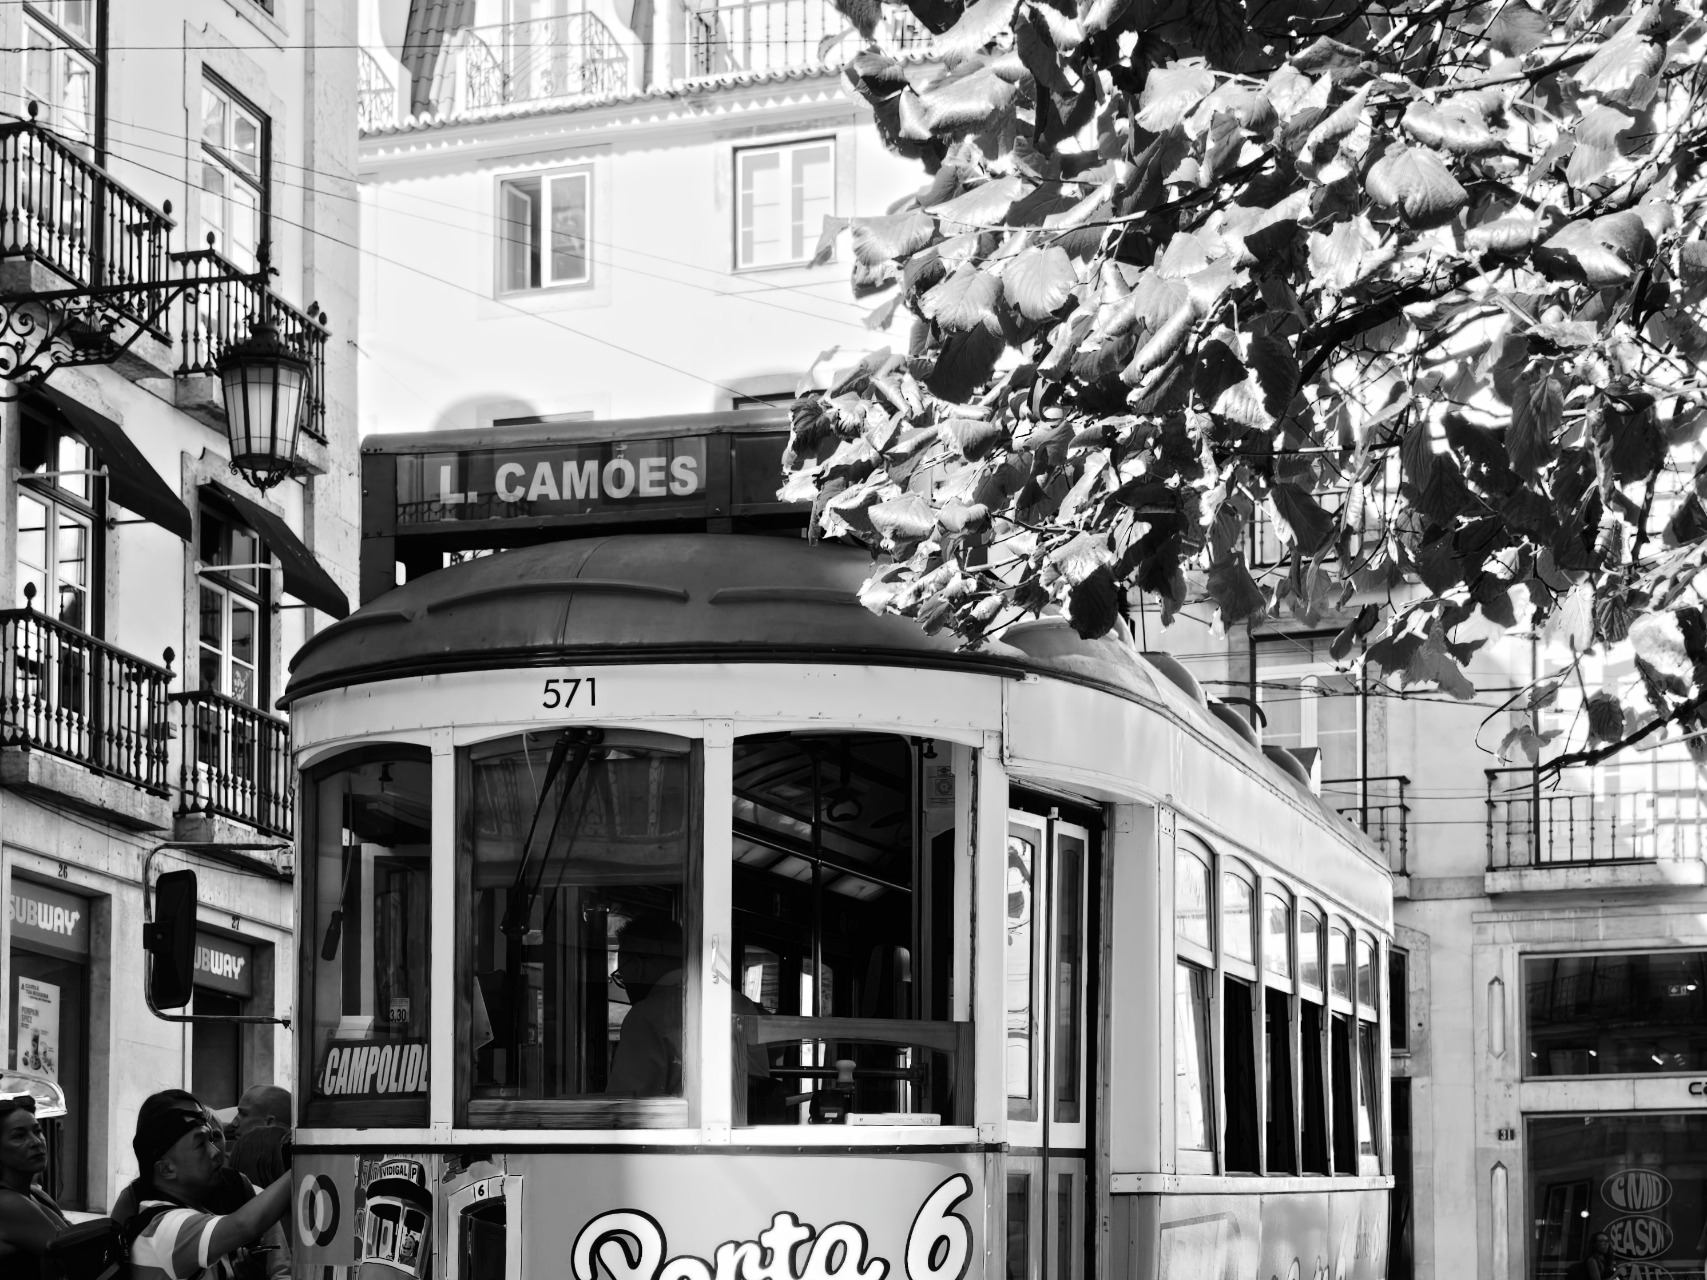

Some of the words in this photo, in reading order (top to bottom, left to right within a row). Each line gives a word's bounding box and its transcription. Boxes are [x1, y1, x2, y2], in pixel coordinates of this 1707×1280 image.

[439, 465, 478, 504] L.
[542, 677, 597, 709] 571
[58, 863, 68, 879] 26
[231, 915, 240, 931] 27
[194, 945, 246, 980] UBWAY
[382, 1164, 408, 1177] VIDIGAL
[411, 1167, 417, 1180] P
[477, 1184, 485, 1197] 6
[1610, 1218, 1665, 1257] SEASON
